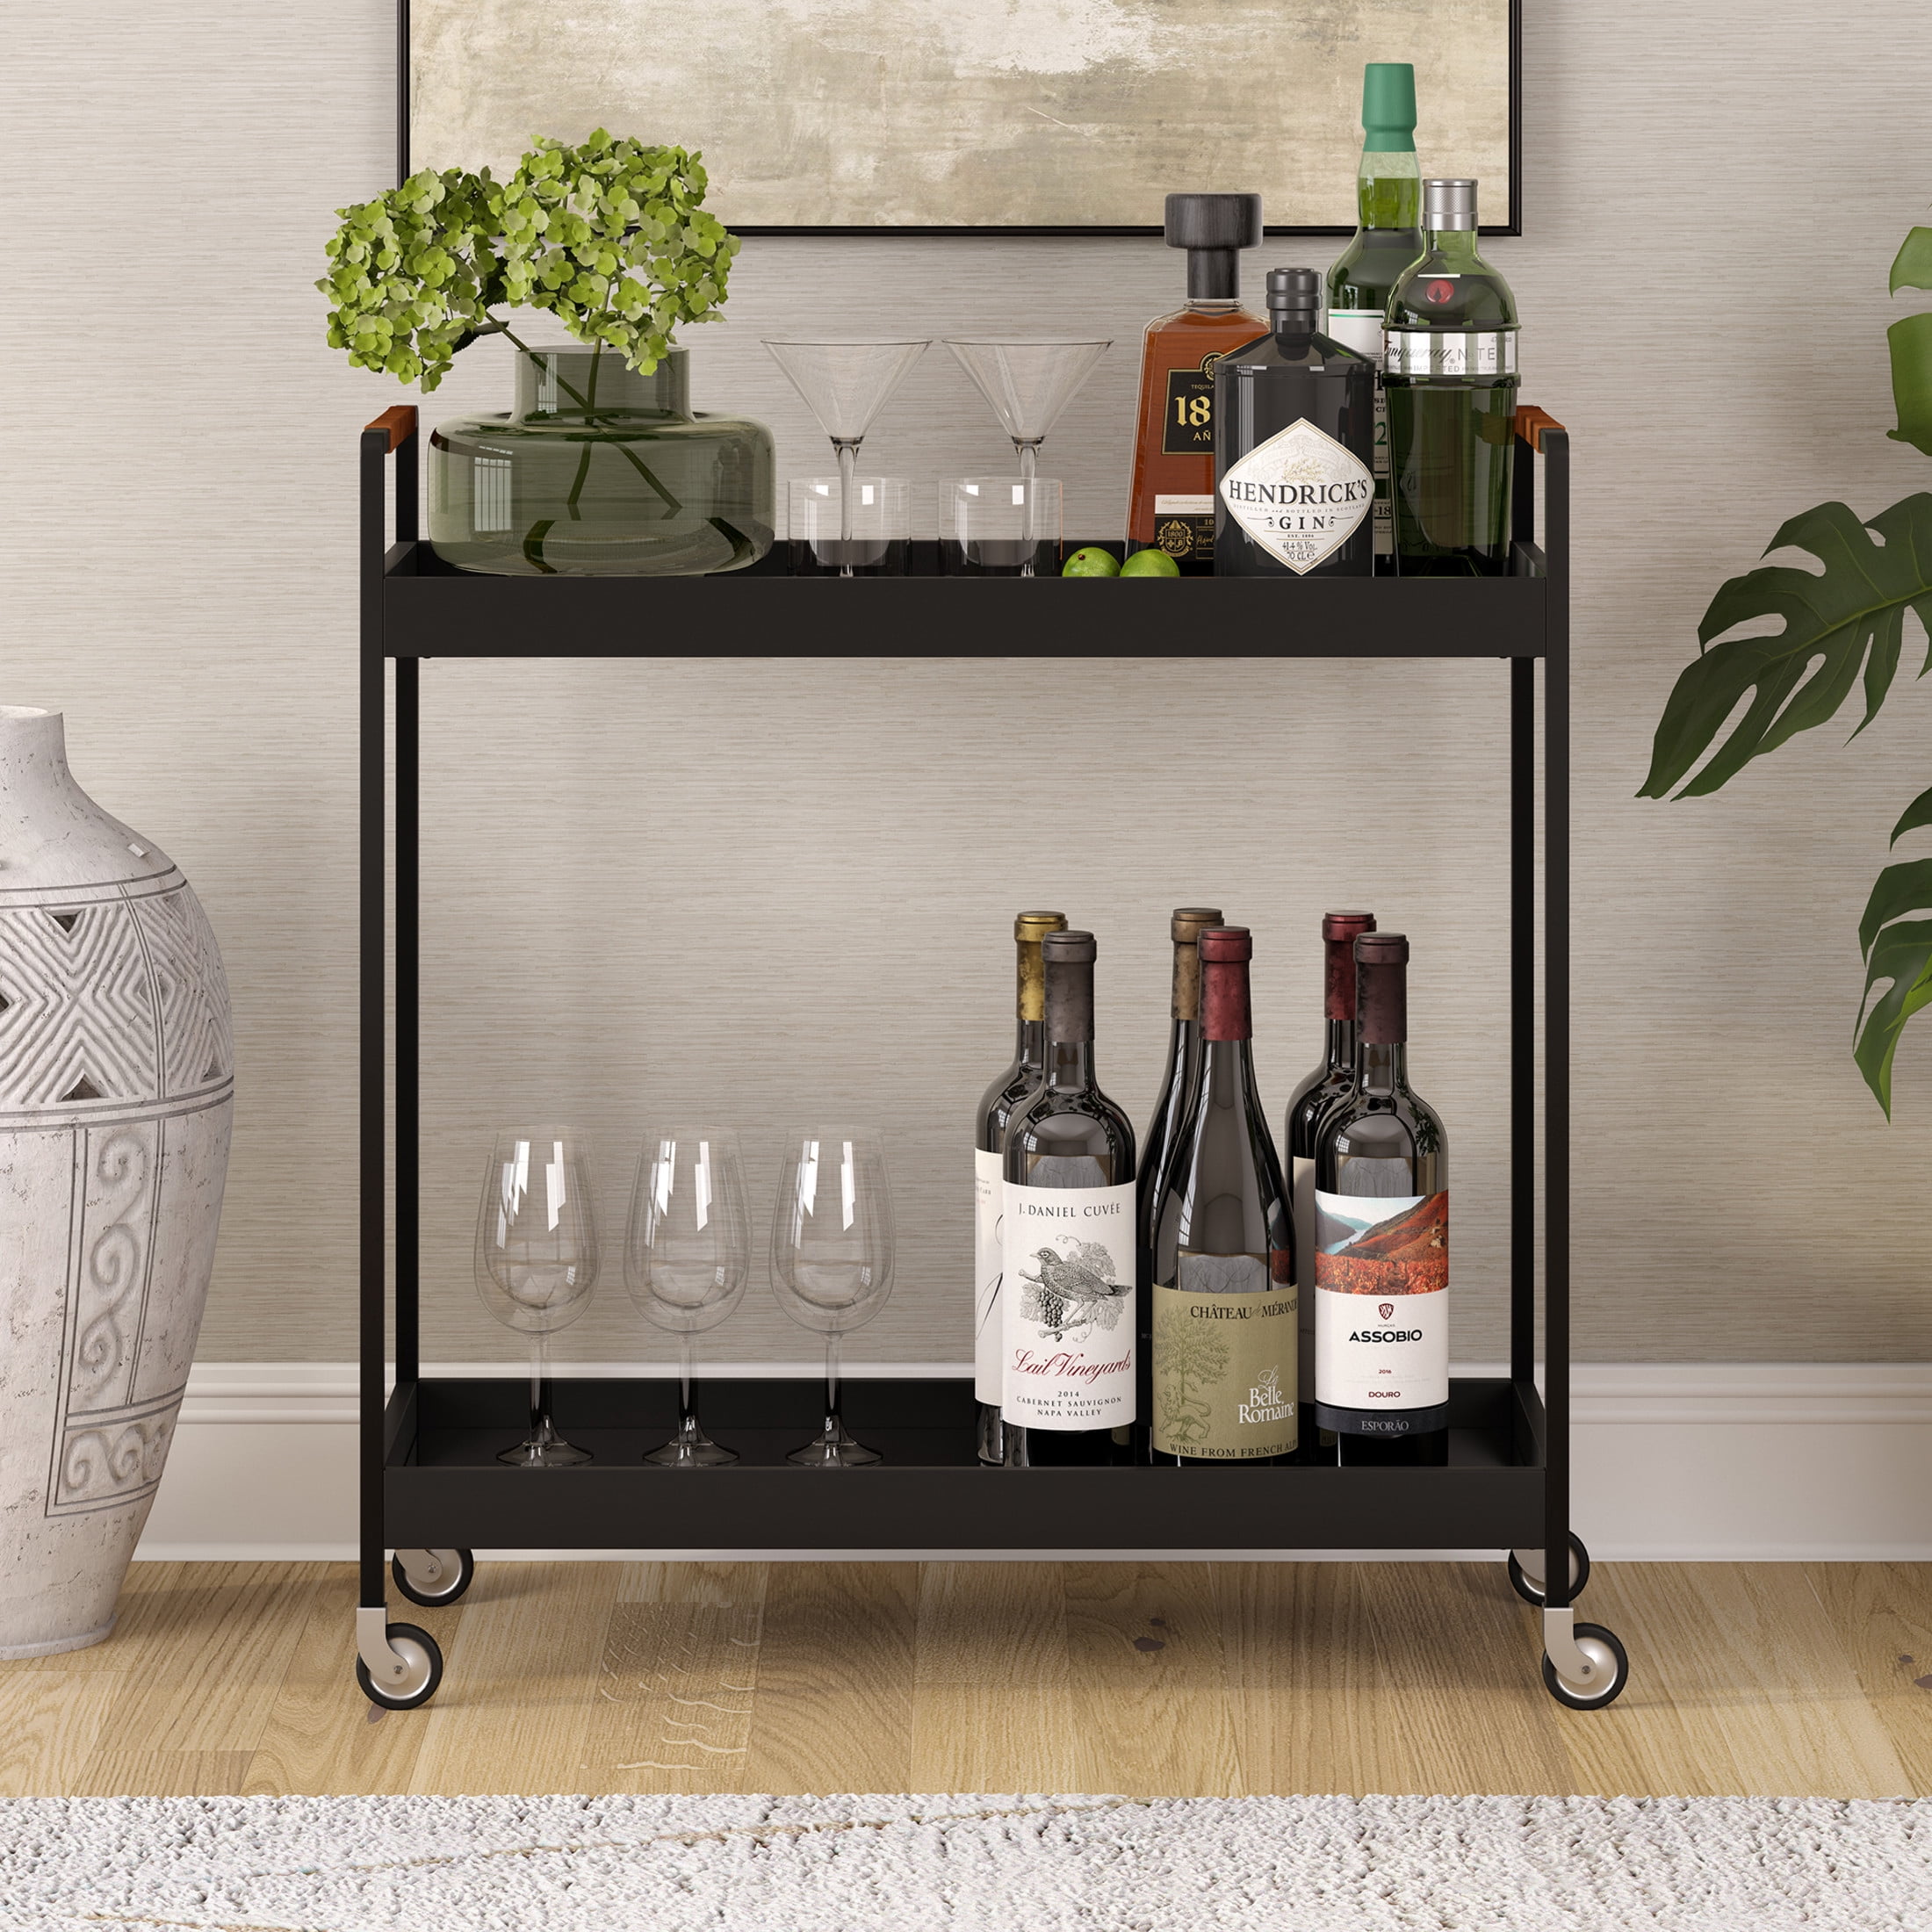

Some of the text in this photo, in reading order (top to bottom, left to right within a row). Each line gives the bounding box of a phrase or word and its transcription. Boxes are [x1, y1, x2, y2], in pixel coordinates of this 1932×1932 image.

[1229, 479, 1367, 505] HENDRICK'S
[1279, 515, 1325, 530] GIN
[1084, 1201, 1121, 1218] CUVÉE
[1191, 1304, 1252, 1319] CHÂTEAU
[1349, 1330, 1423, 1343] ASSOBIO
[1054, 1349, 1131, 1385] Vineyards
[1017, 1396, 1121, 1407] CABERNET SAUVIGNON
[1238, 1402, 1294, 1424] Romaine
[1361, 1420, 1409, 1431] ESPORÃO
[1170, 1443, 1197, 1455] WINE
[1201, 1447, 1236, 1458] FROM
[1241, 1445, 1283, 1458] FRENCH
